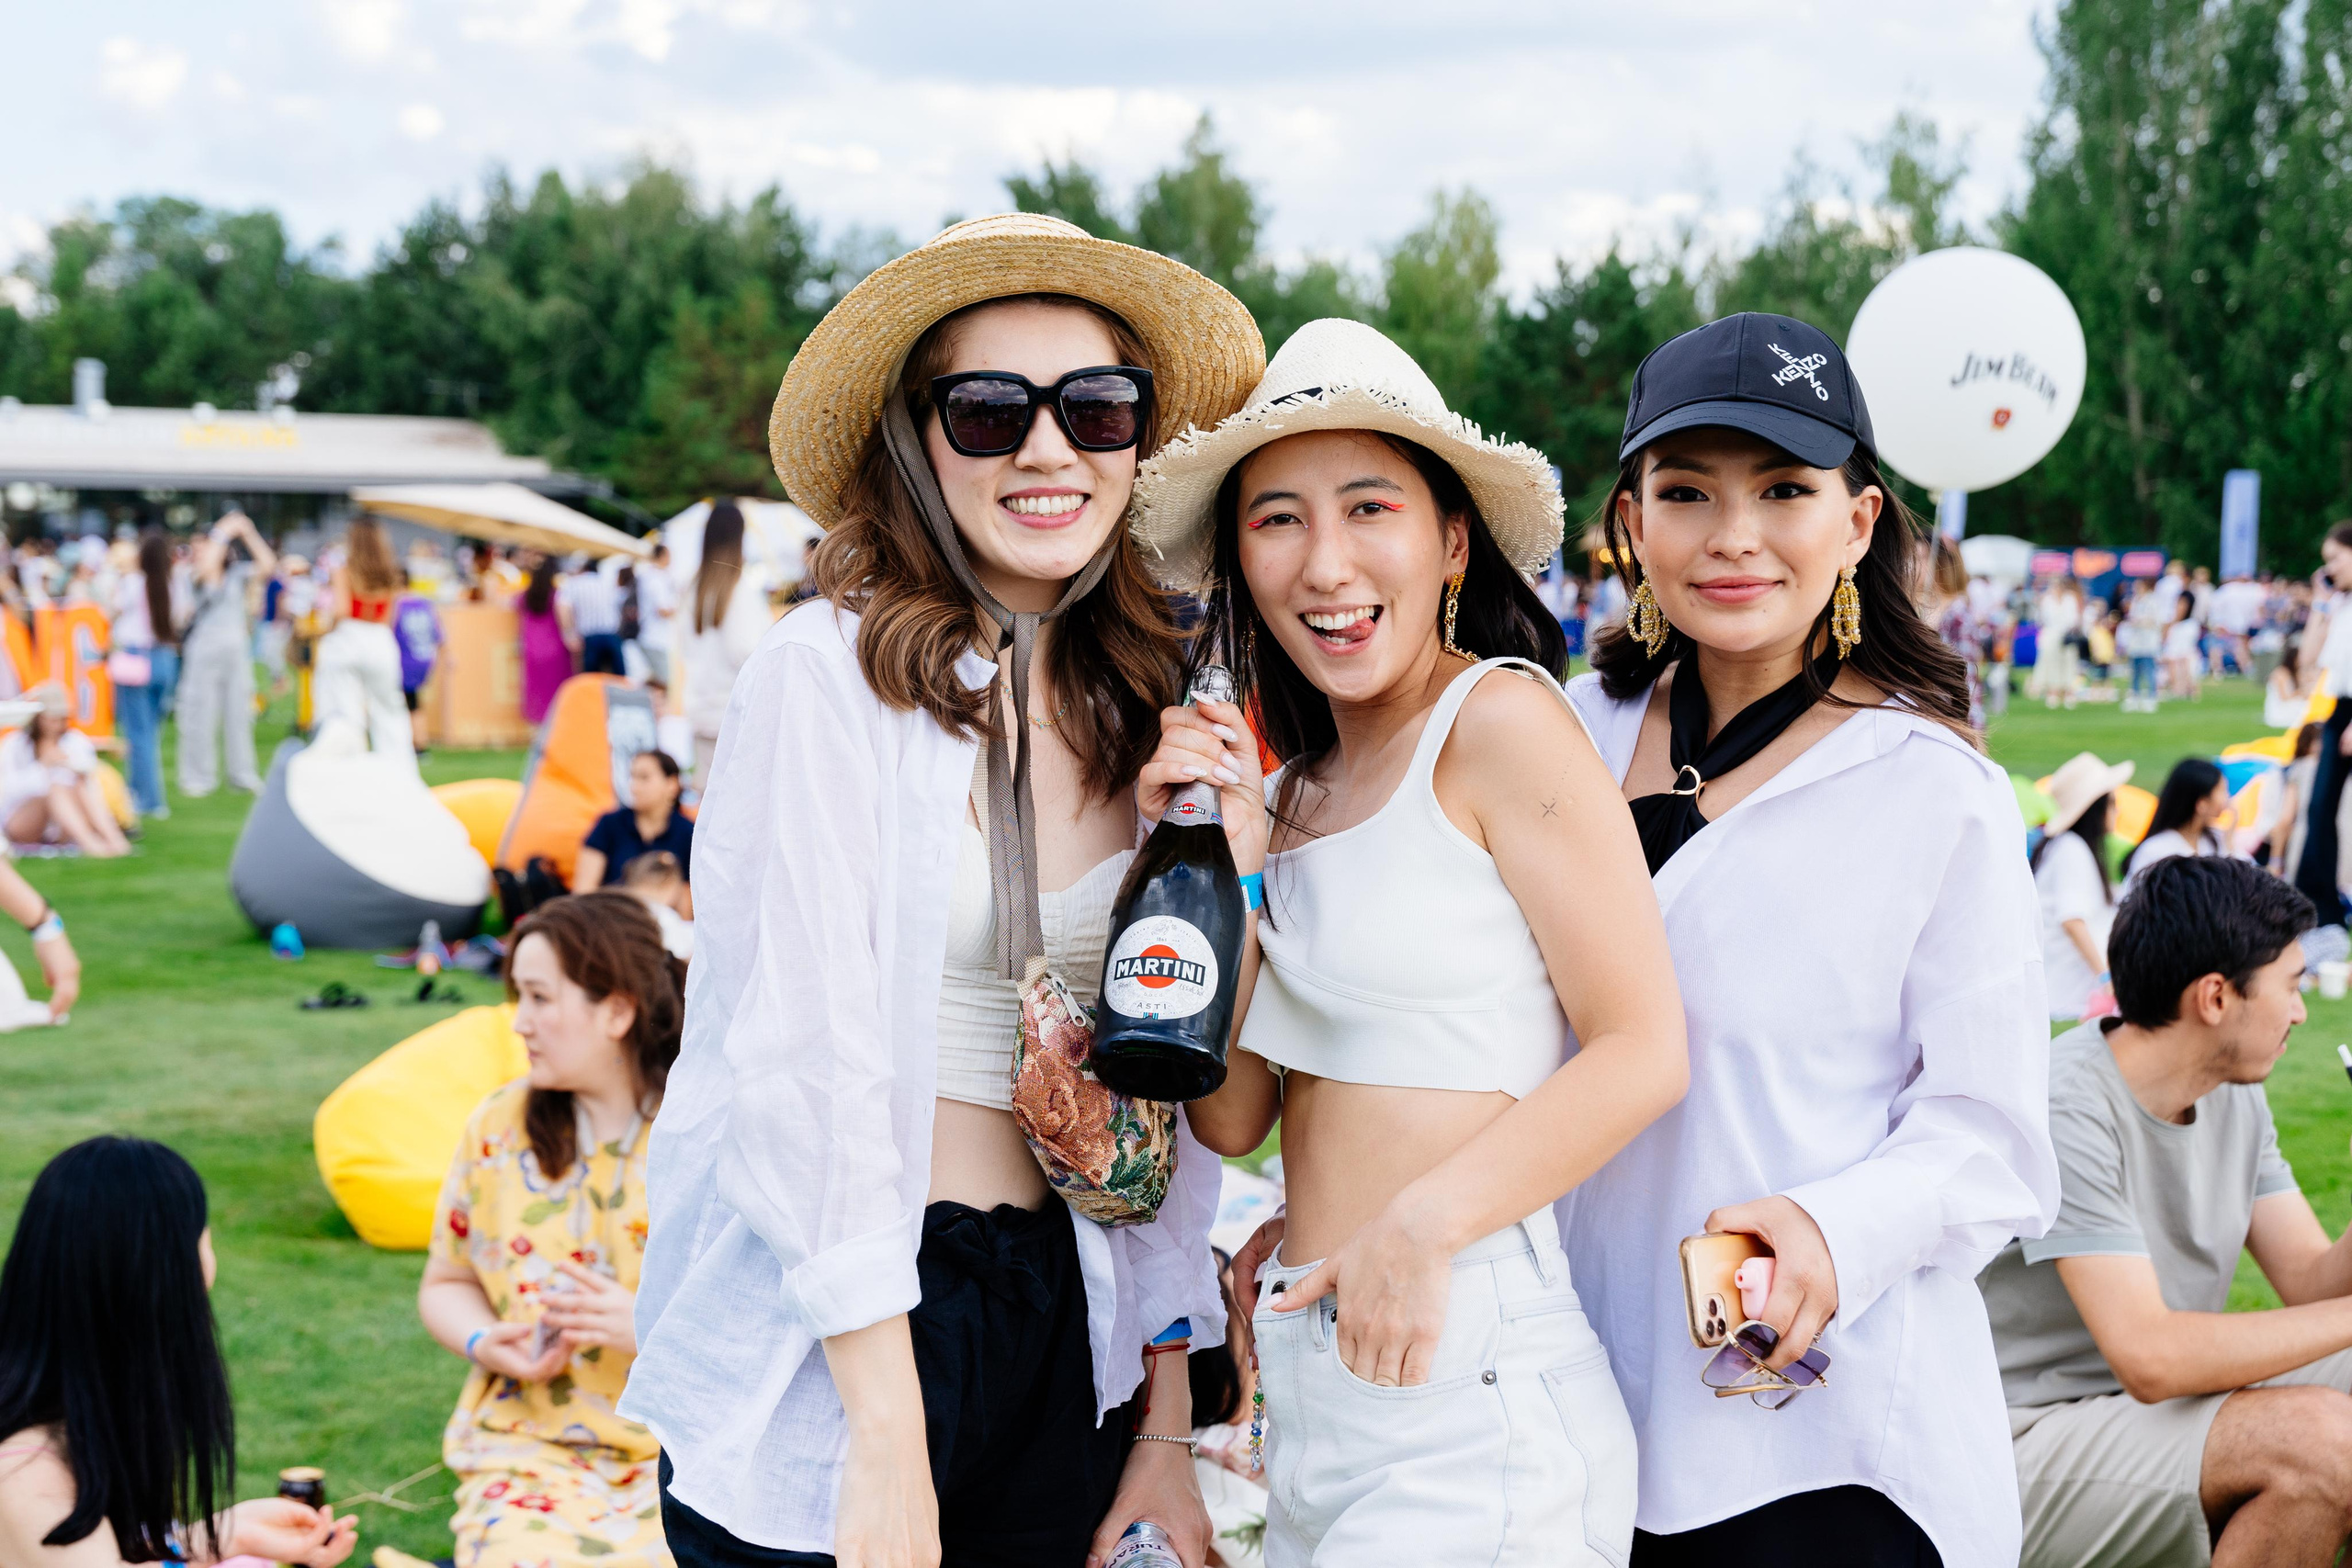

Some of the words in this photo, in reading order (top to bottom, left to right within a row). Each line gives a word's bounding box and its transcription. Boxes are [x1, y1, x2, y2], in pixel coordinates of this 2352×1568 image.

[1172, 806, 1205, 814] MARTINI
[1116, 958, 1204, 984] MARTINI
[1136, 1001, 1167, 1010] ASTI
